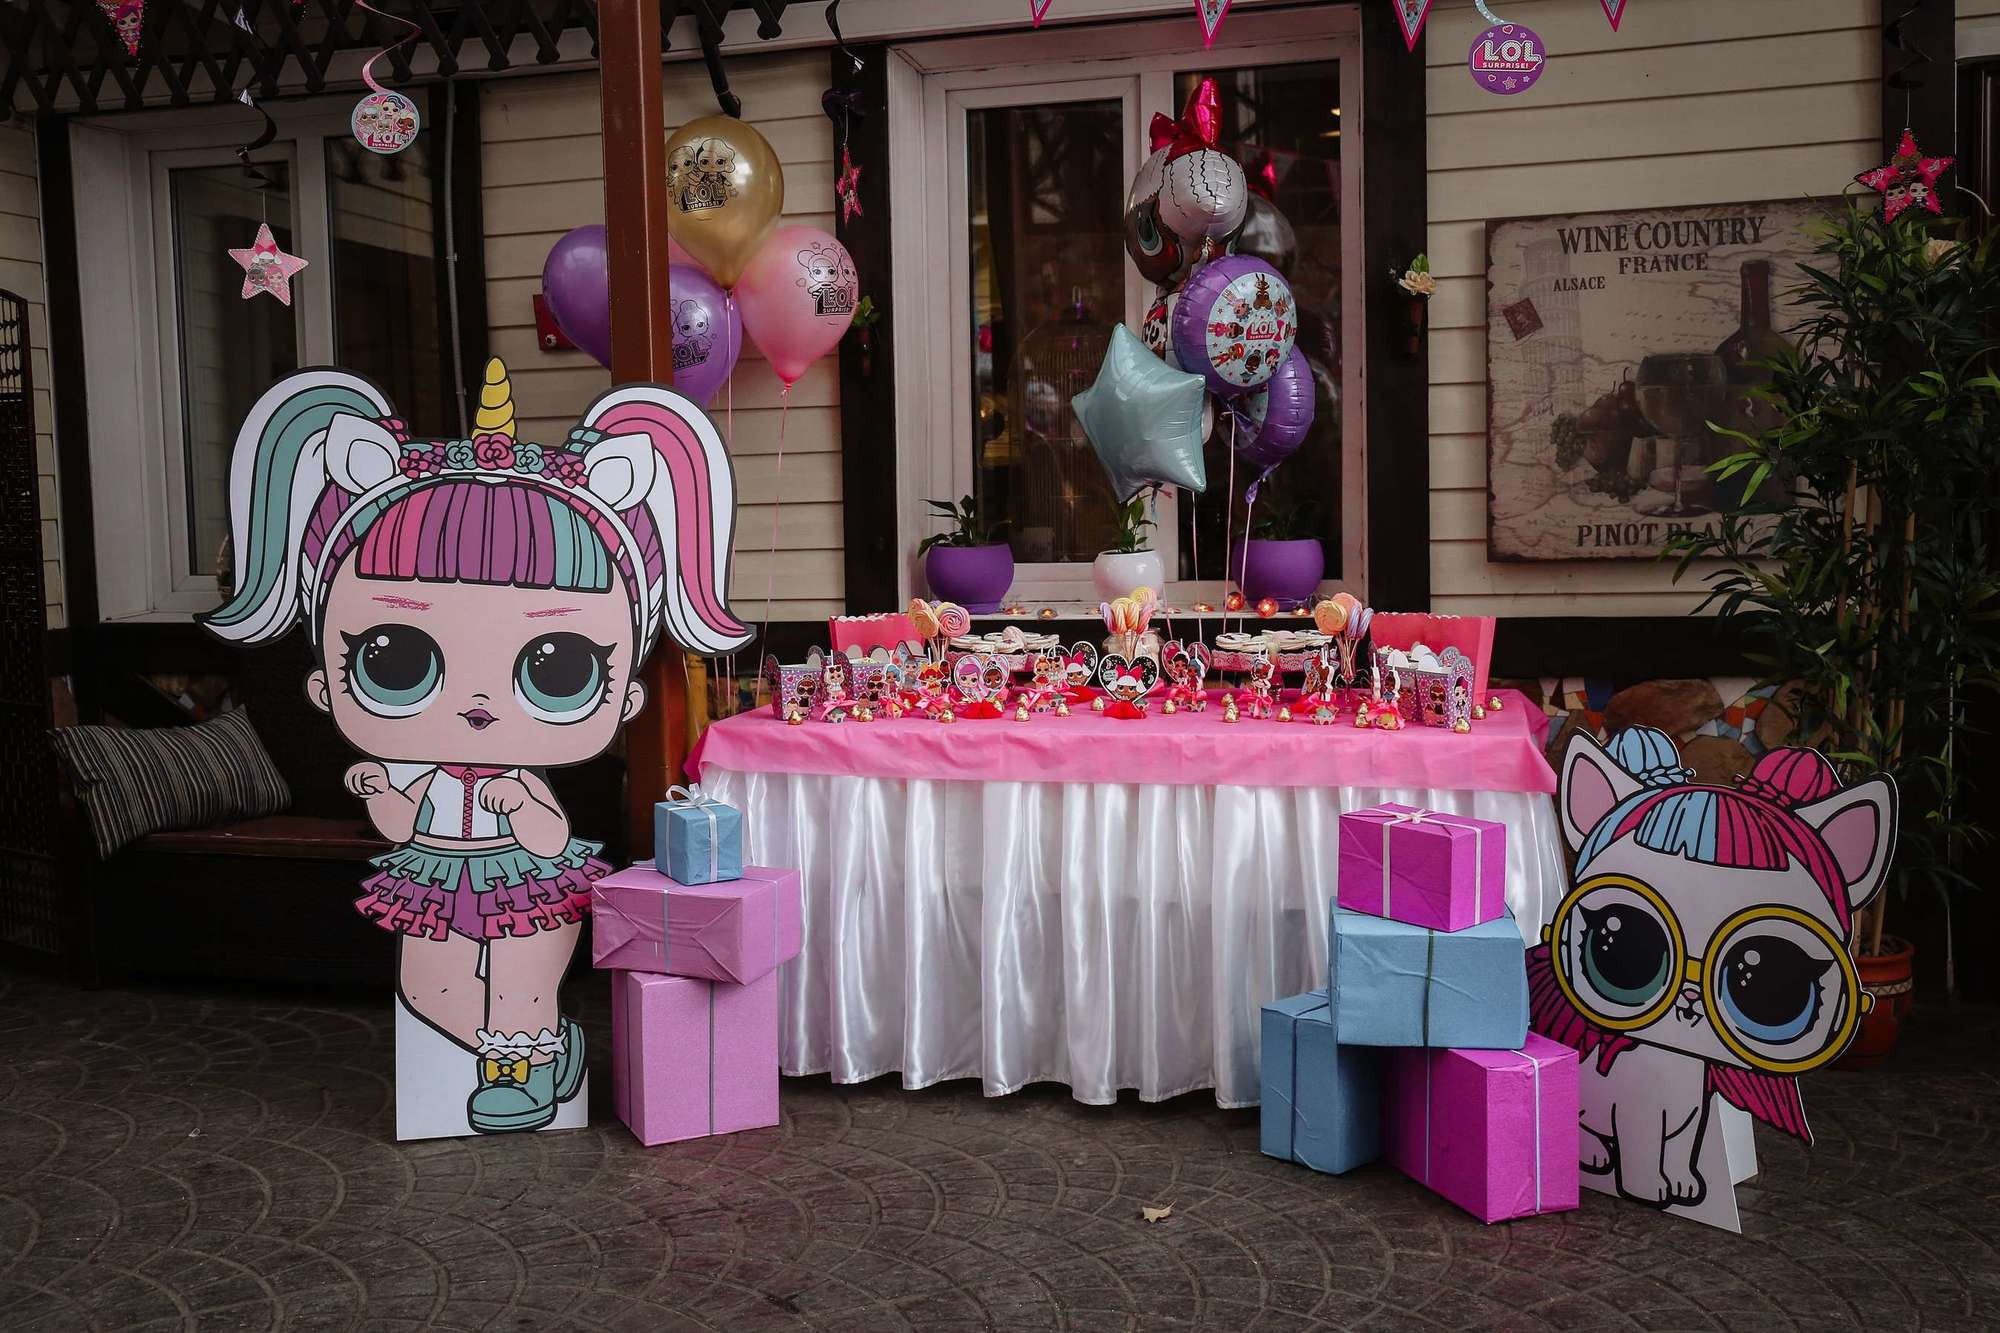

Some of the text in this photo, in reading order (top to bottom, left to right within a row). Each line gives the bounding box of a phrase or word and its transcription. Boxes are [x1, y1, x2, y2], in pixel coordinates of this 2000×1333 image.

[1557, 216, 1767, 255] WINE COUNTRY
[1618, 252, 1710, 275] FRANCE
[1553, 275, 1606, 292] ALSACE
[1576, 522, 1659, 548] PINOT
